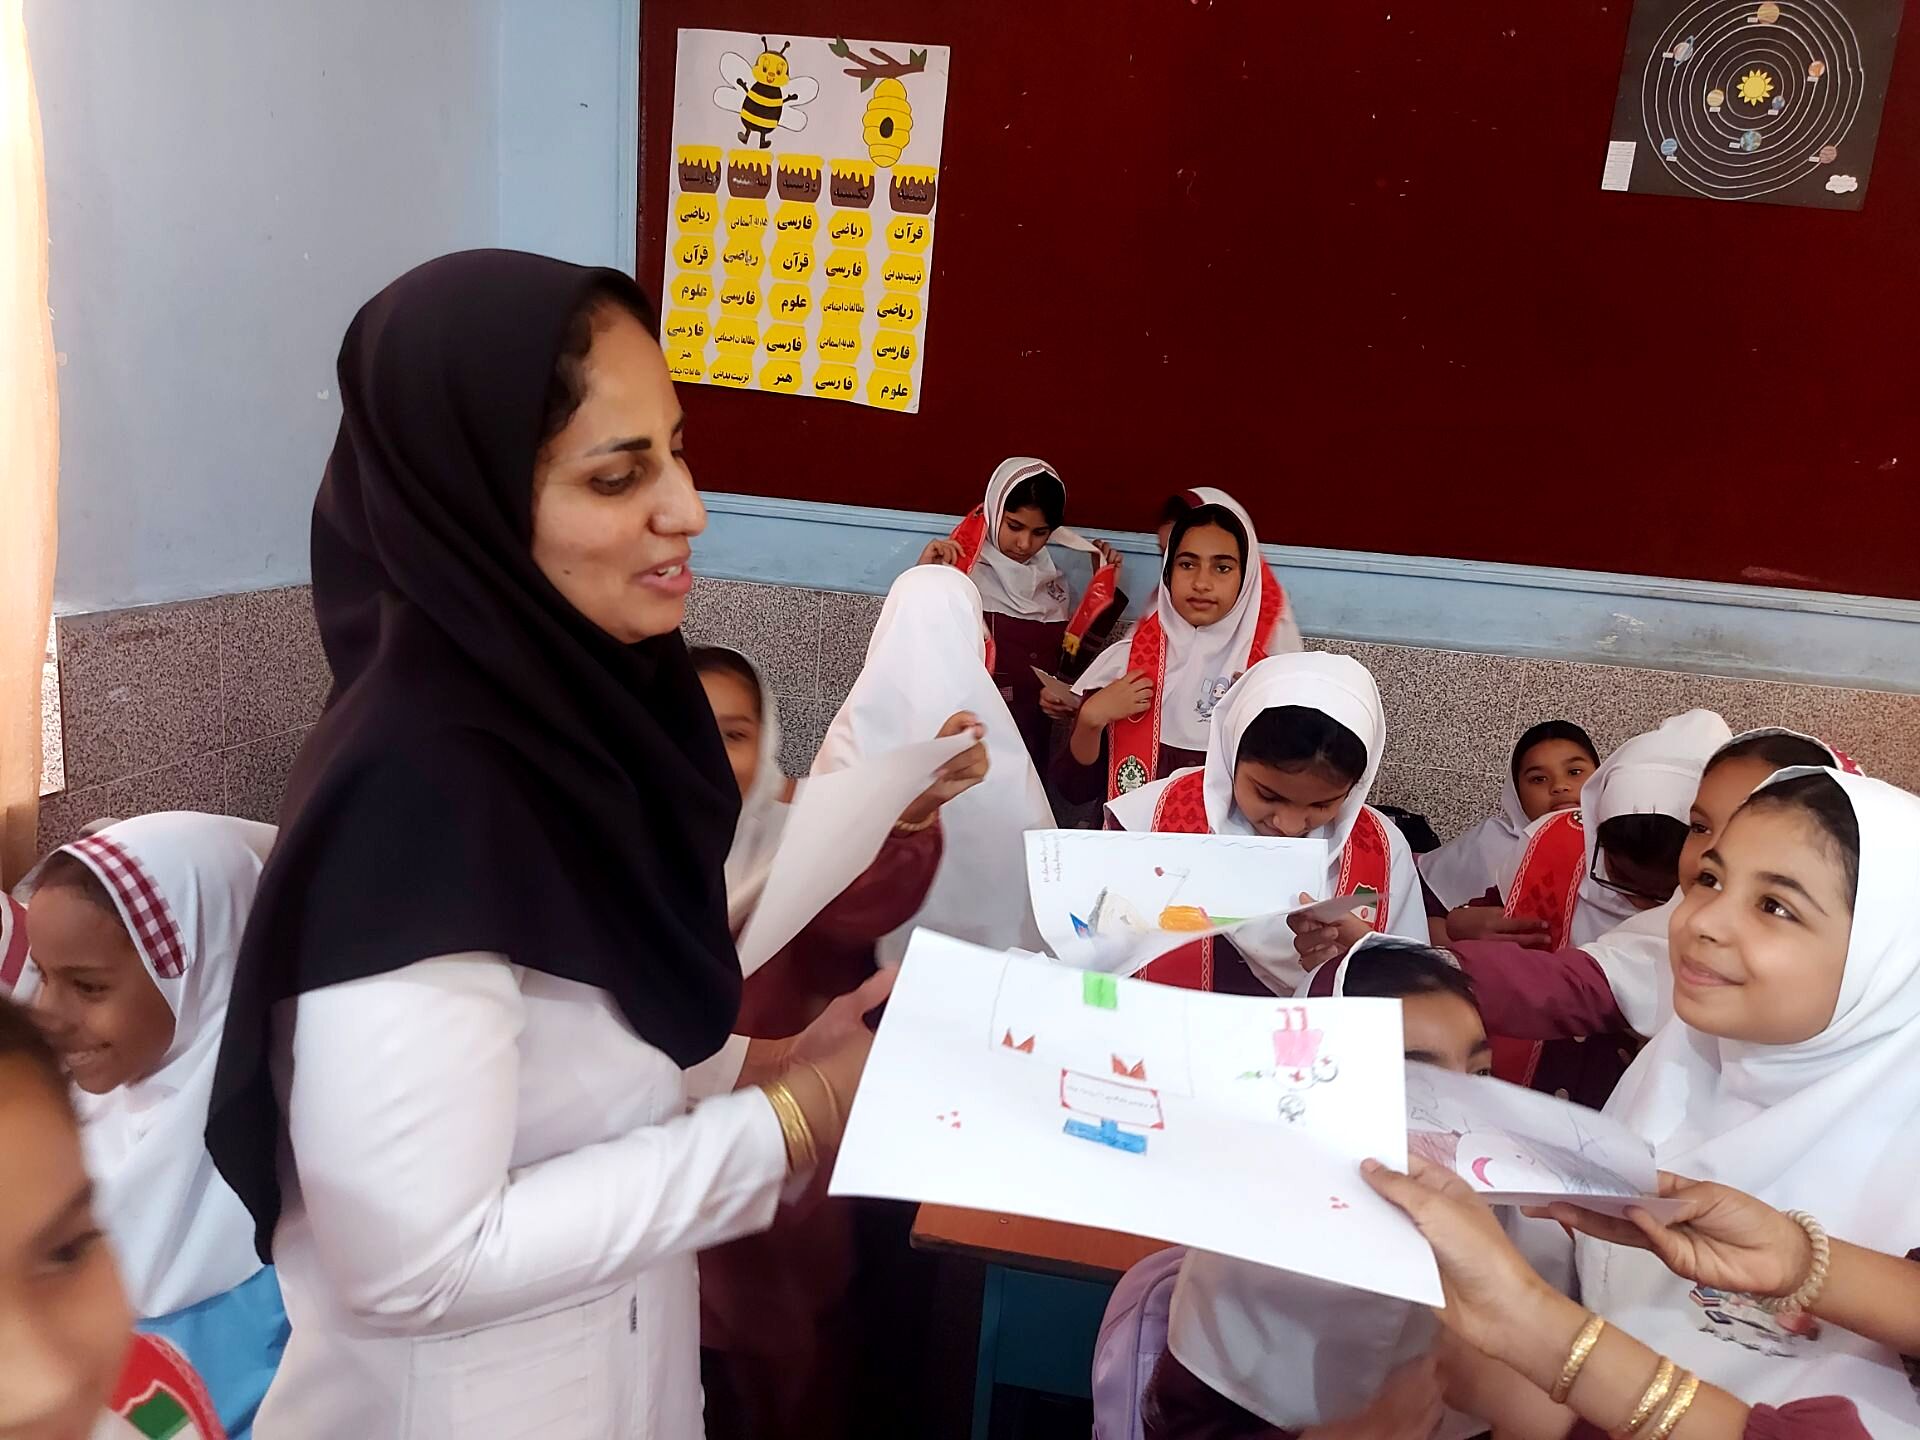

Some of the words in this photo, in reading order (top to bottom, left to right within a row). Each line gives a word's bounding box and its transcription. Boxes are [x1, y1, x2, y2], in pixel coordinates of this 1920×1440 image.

[680, 205, 711, 225] ریاضی
[777, 215, 813, 231] فارسی
[831, 223, 864, 240] ریاضی
[893, 222, 924, 244] قرآن
[682, 244, 709, 266] قرآن
[723, 249, 759, 266] ریاضی
[782, 252, 809, 273] قرآن
[825, 261, 862, 279] فارسی
[681, 283, 707, 301] علوم
[720, 290, 756, 306] فارسی
[781, 294, 808, 313] علوم
[876, 302, 914, 322] ریاضی
[666, 321, 704, 338] فارسی
[766, 337, 802, 353] فارسی
[876, 344, 910, 361] فارسی
[679, 349, 692, 360] هنر
[773, 373, 793, 386] هنر
[815, 375, 853, 391] فارسی
[880, 383, 909, 400] علوم
